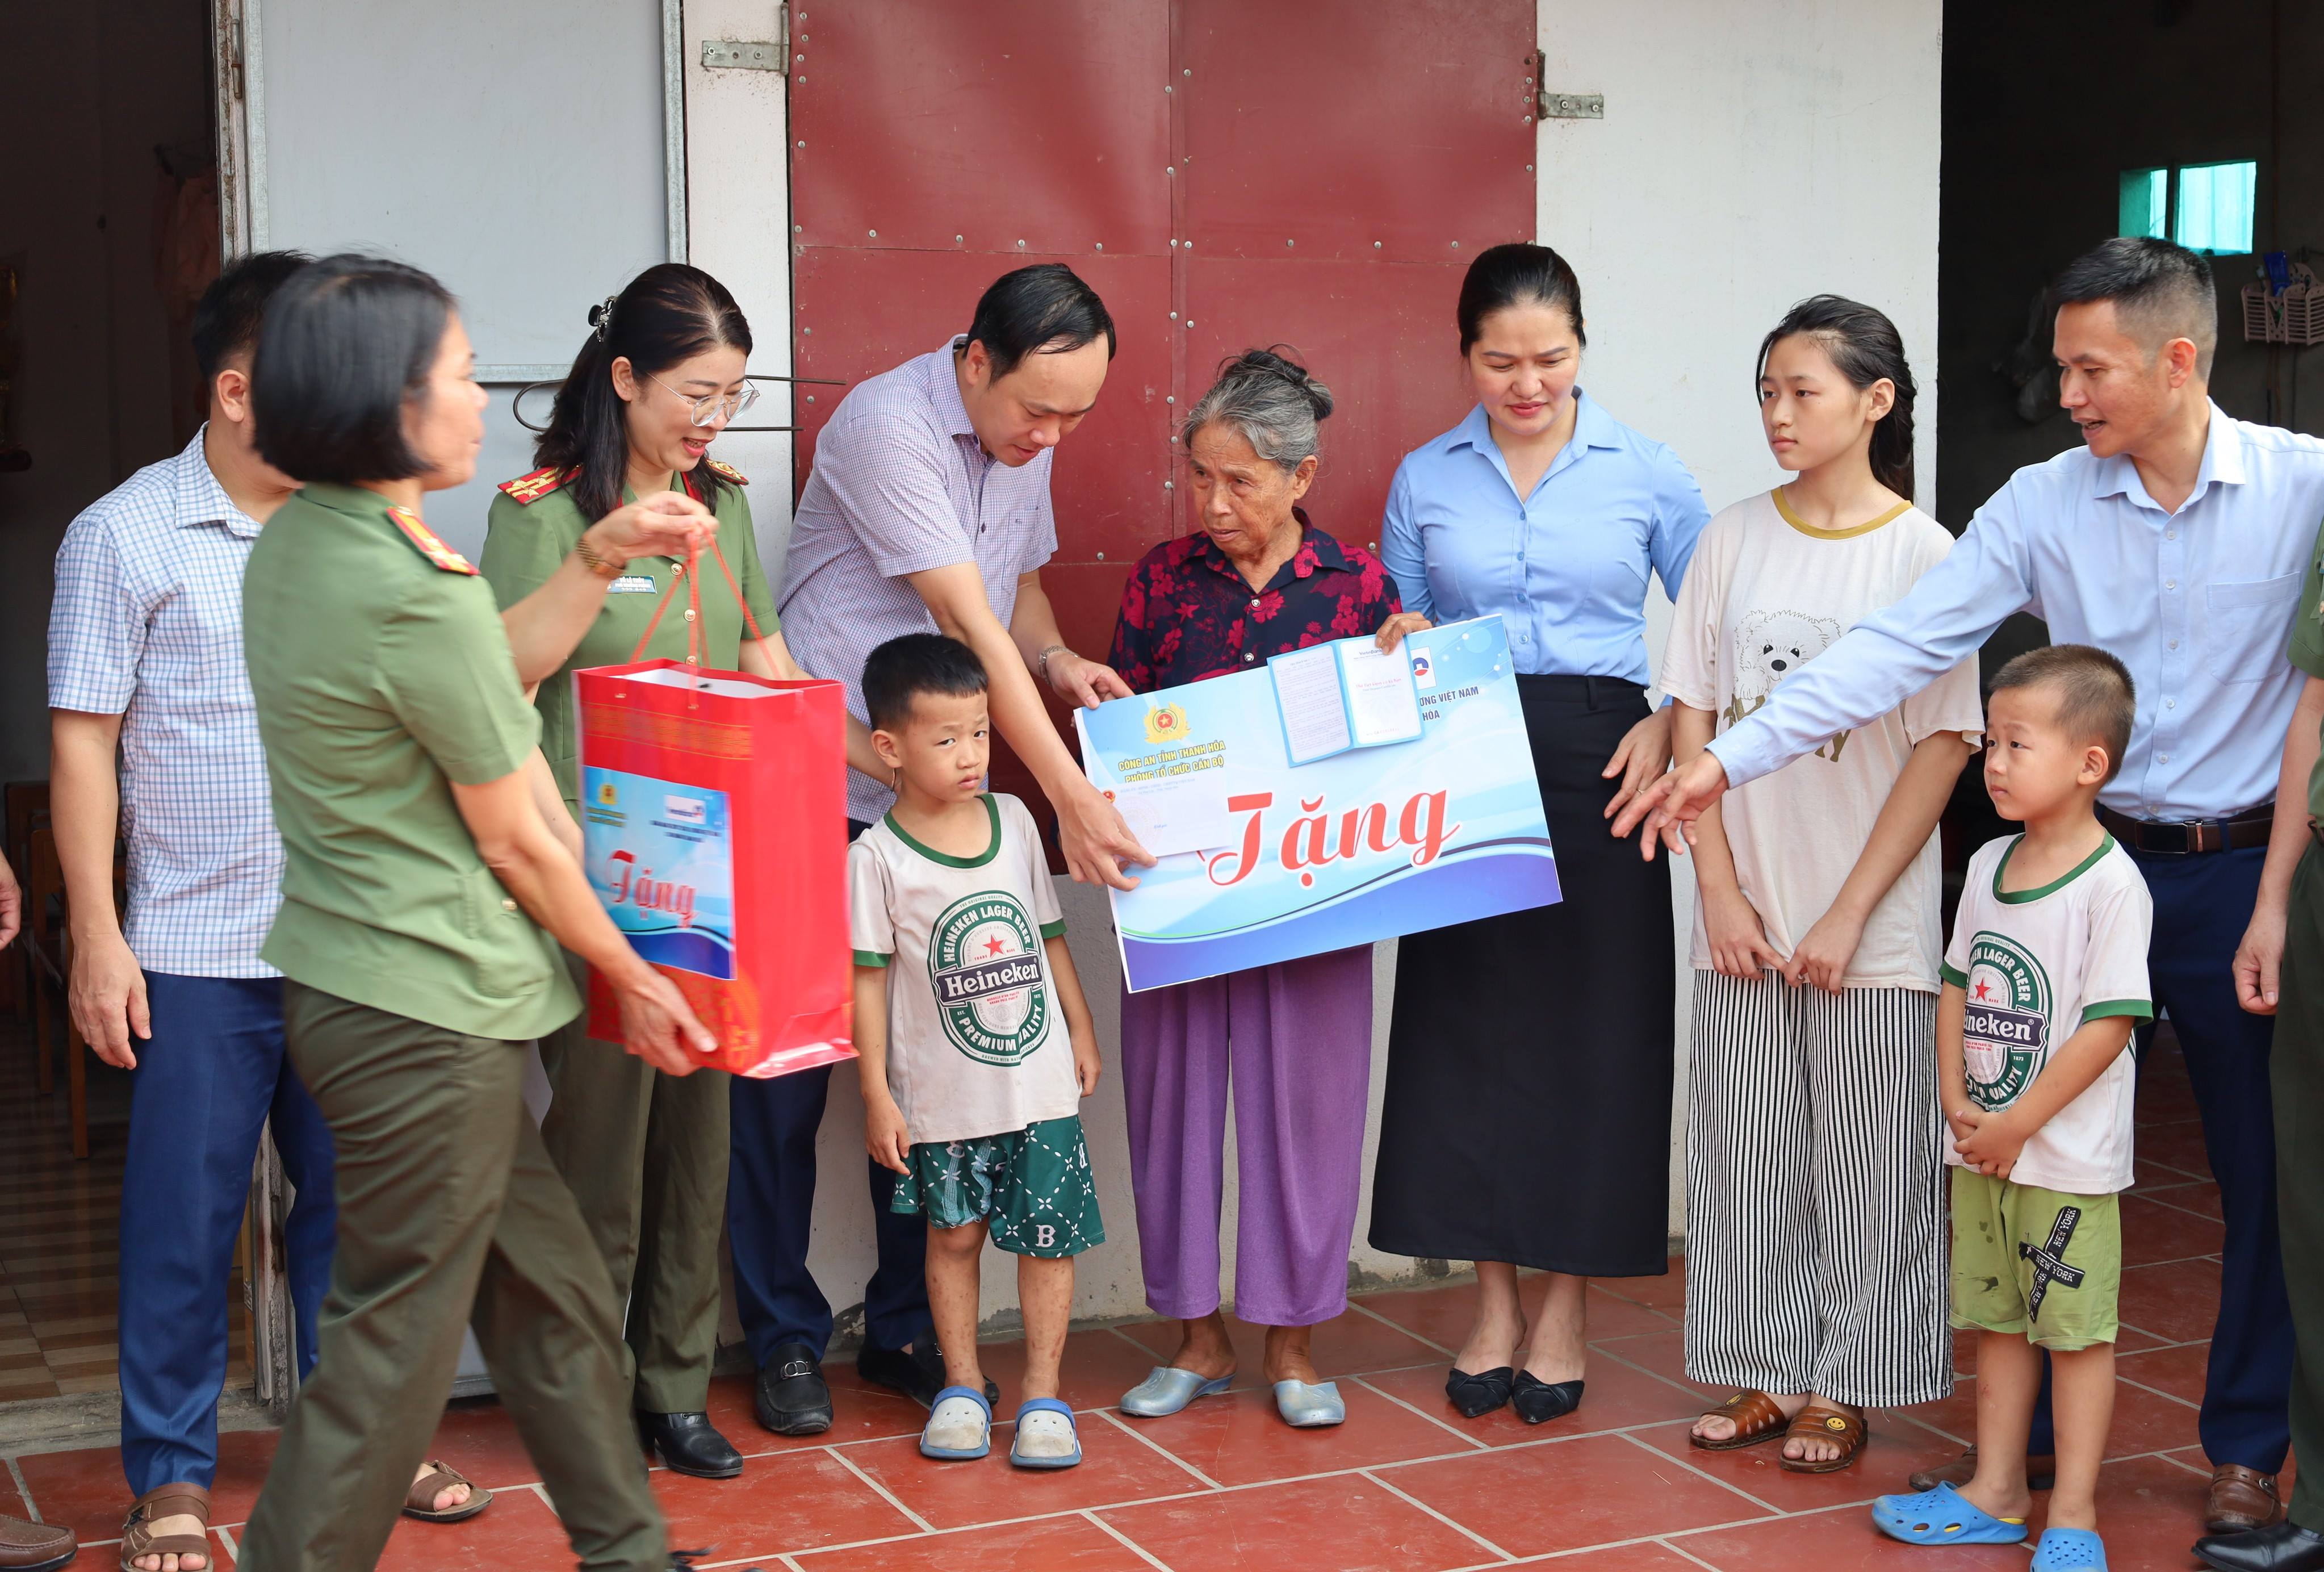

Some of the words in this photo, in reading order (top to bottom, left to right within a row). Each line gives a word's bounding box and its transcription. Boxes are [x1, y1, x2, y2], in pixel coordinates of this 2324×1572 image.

[1419, 695, 1437, 706] ƠNG
[1438, 690, 1456, 703] VIỆT
[1458, 686, 1479, 699] NAM
[1422, 709, 1441, 721] HÓA
[1118, 758, 1142, 772] CÔNG
[1144, 755, 1156, 767] AN
[1178, 743, 1207, 759] THANH
[1207, 739, 1226, 755] HÓA
[1168, 762, 1191, 776] CHỨC
[1192, 757, 1211, 771] CÁN
[1211, 754, 1224, 768] BỘ
[1208, 789, 1460, 887] Tặng
[968, 896, 987, 905] ORIGINAL
[943, 909, 980, 963] HEINEKEN
[979, 905, 1014, 920] LAGER
[1014, 914, 1031, 945] BEER
[1995, 939, 2011, 948] QUALITY
[944, 962, 1039, 998] Heineken
[1983, 947, 2016, 972] LAGER
[2012, 968, 2031, 1002] BEER
[958, 1017, 1017, 1051] PREMIUM
[1019, 1004, 1042, 1046] ALITY
[1965, 1009, 2032, 1041] ineken
[2059, 1208, 2076, 1230] YORK
[1035, 1224, 1056, 1248] B
[2036, 1254, 2053, 1272] NEW
[2052, 1264, 2075, 1282] YORK
